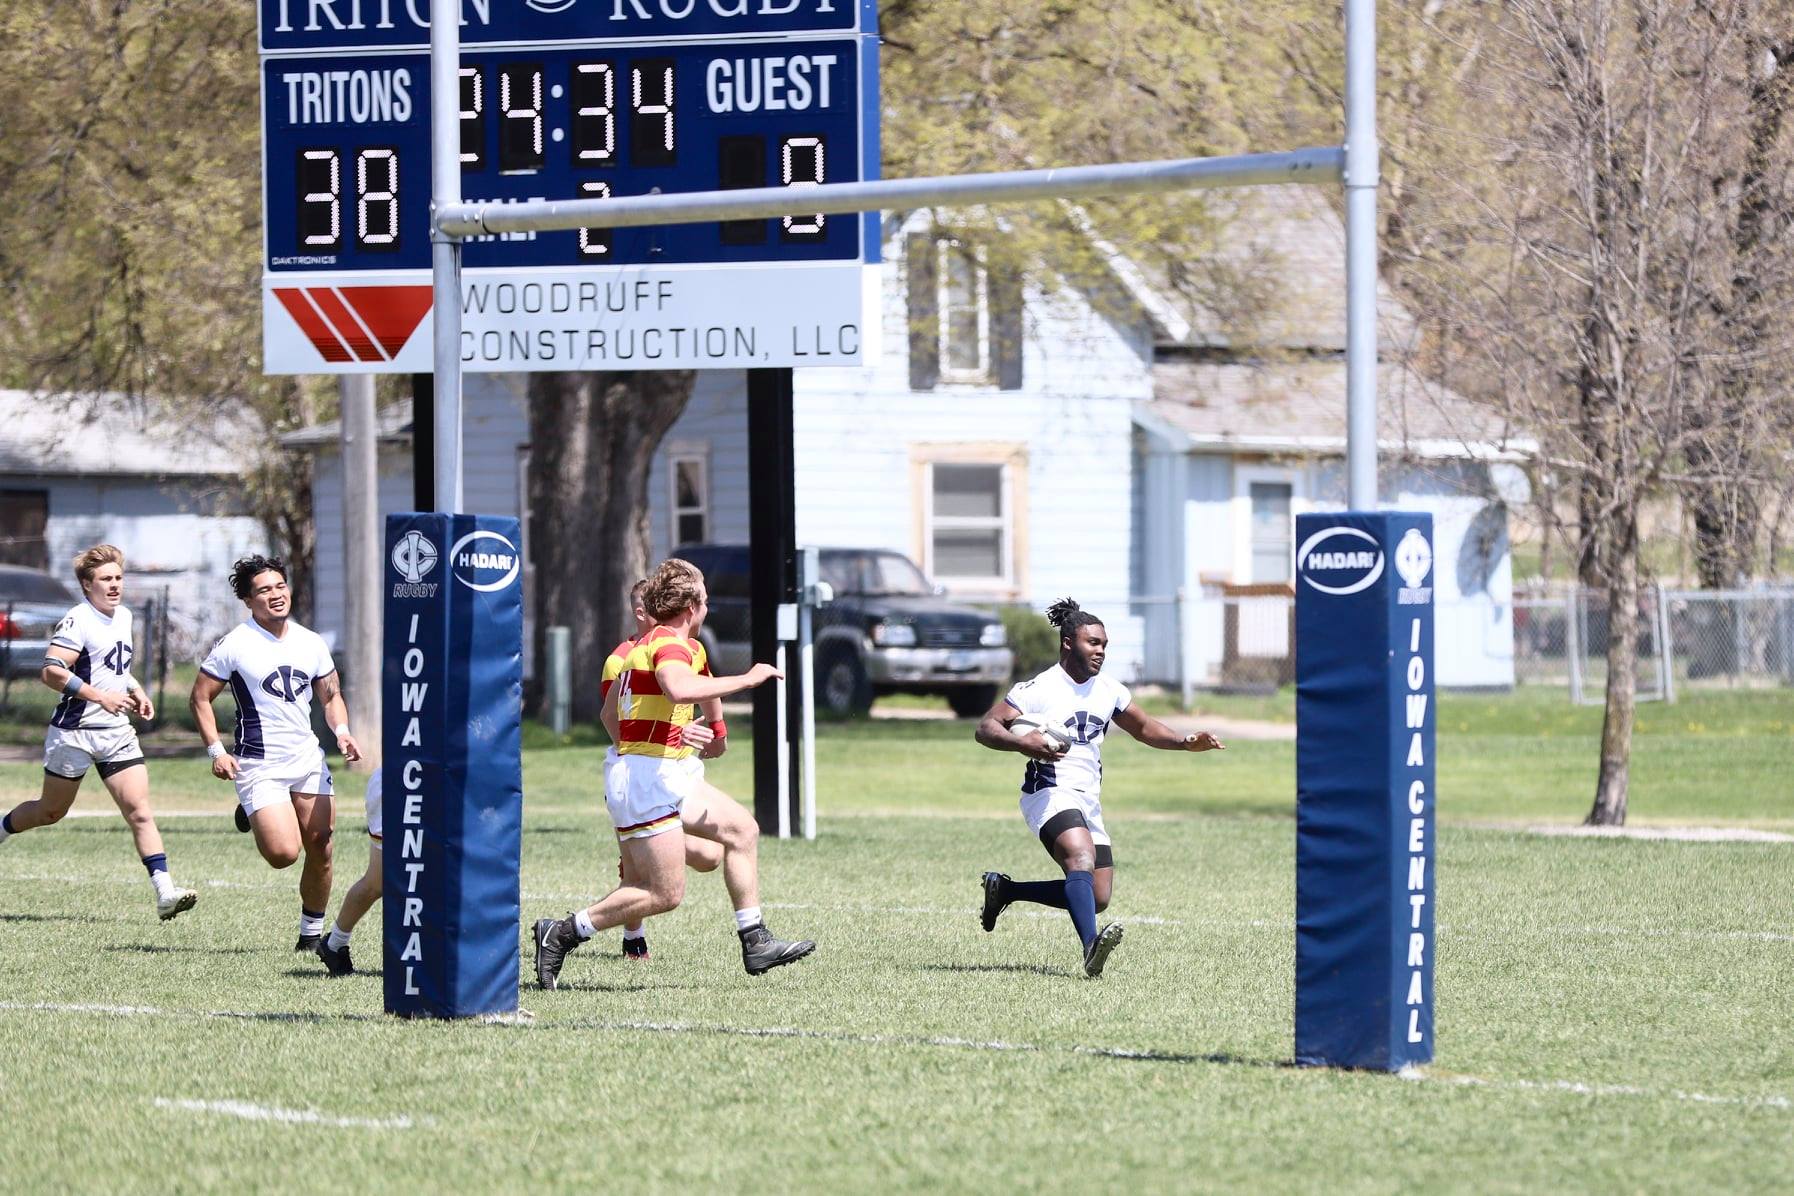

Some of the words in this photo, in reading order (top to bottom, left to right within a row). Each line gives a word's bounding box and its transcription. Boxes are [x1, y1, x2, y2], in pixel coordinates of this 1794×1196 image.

[283, 68, 412, 124] TRITONS
[706, 55, 837, 113] GUEST
[303, 149, 398, 245] 38
[461, 281, 674, 315] WOODRUFF
[792, 324, 859, 356] LLC
[393, 583, 438, 598] RUGBY
[401, 613, 428, 747] IOWA
[1406, 618, 1428, 767] IOWA
[400, 760, 425, 996] CENTRAL
[1406, 780, 1425, 1043] CENTRAL
